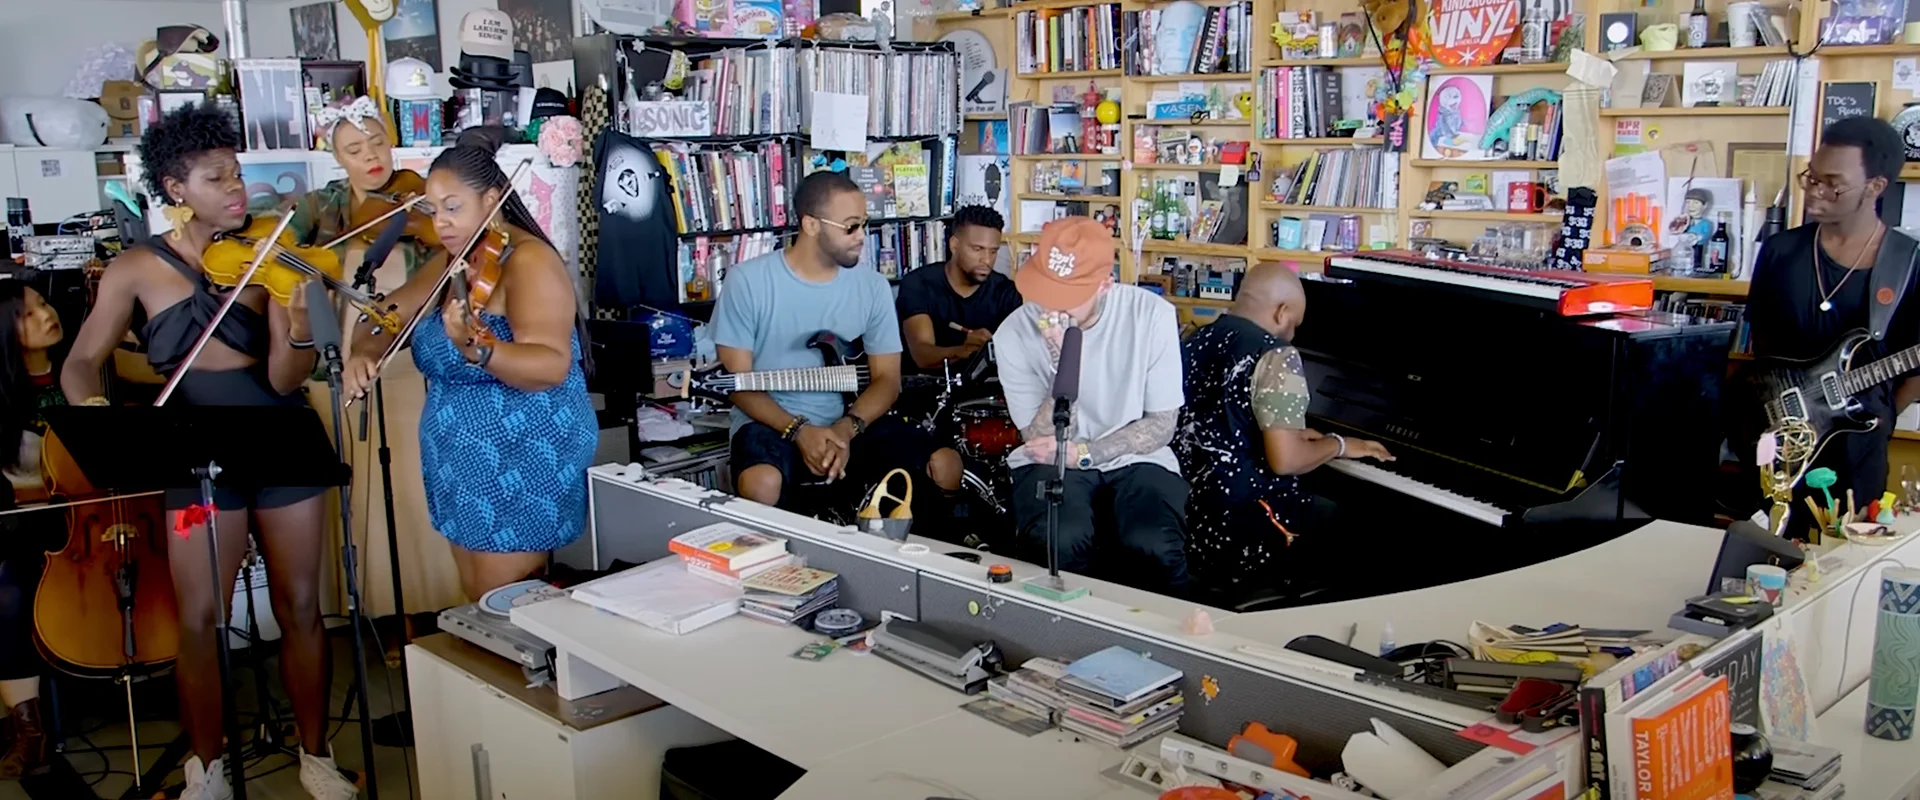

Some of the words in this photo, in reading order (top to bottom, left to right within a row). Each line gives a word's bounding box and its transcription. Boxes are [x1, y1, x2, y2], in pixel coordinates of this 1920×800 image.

[473, 25, 508, 35] LAKSHMI
[735, 10, 768, 26] Twinkies
[1429, 1, 1516, 48] VINYL
[478, 32, 502, 40] SINGH
[640, 104, 705, 133] SONIC
[1656, 689, 1731, 800] TAYLOR
[1635, 730, 1652, 793] TAYLOR
